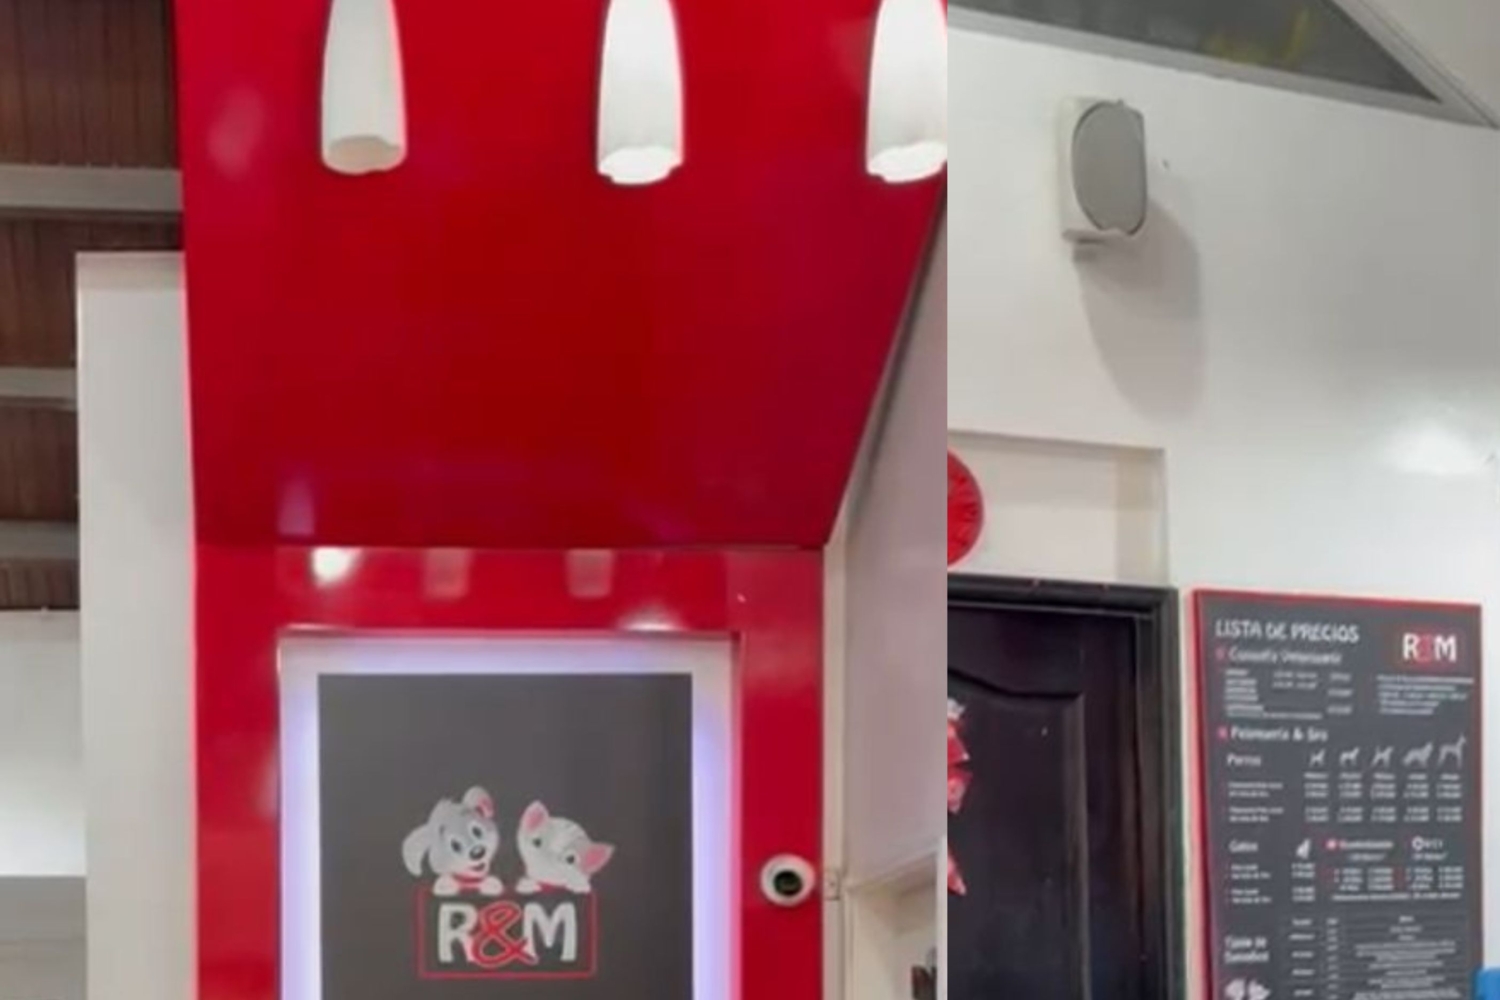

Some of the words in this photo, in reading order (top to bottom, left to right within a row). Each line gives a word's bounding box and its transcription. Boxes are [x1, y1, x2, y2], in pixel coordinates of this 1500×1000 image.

[1214, 619, 1262, 640] LISTA
[1265, 622, 1288, 641] DE
[1291, 622, 1360, 643] PRECIOS
[437, 900, 578, 968] R&M
